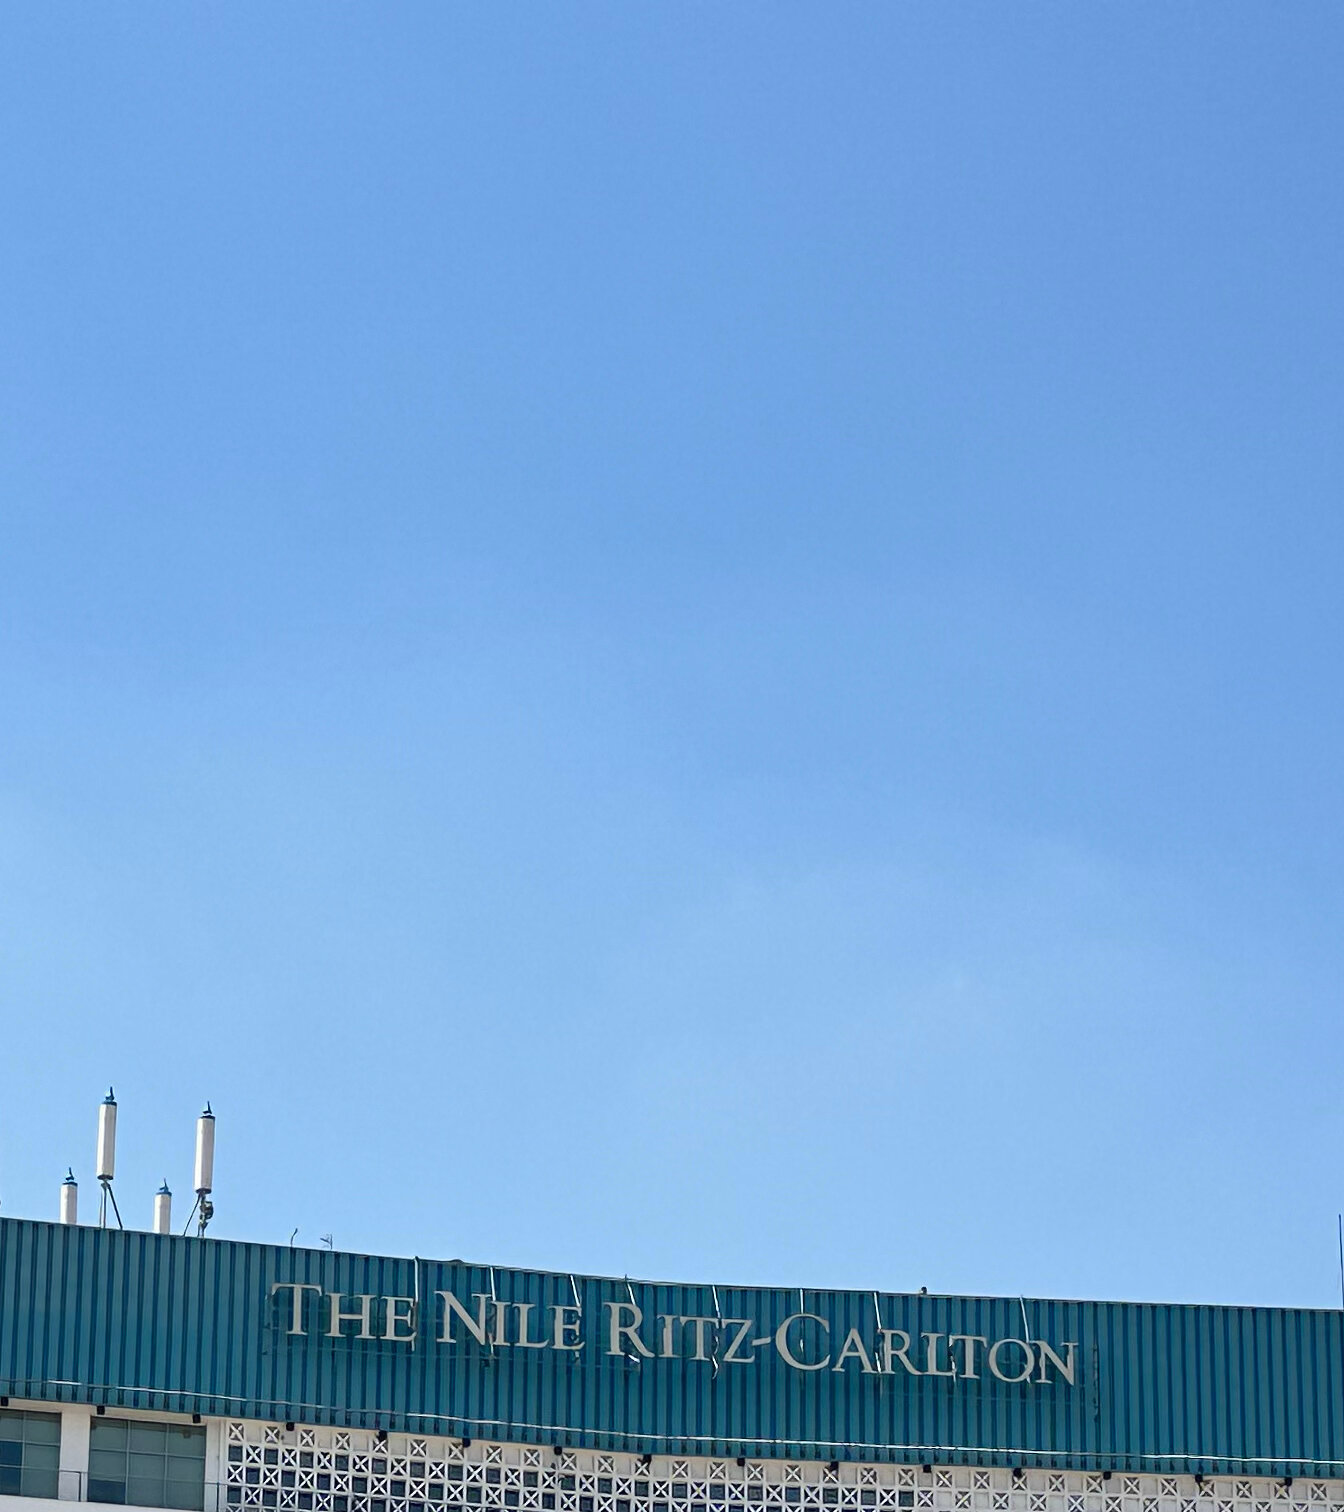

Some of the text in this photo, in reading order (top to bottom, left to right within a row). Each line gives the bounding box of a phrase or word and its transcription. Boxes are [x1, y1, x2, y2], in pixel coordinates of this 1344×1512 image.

[271, 1283, 1080, 1386] THE NILE RITZ-CARLTON
